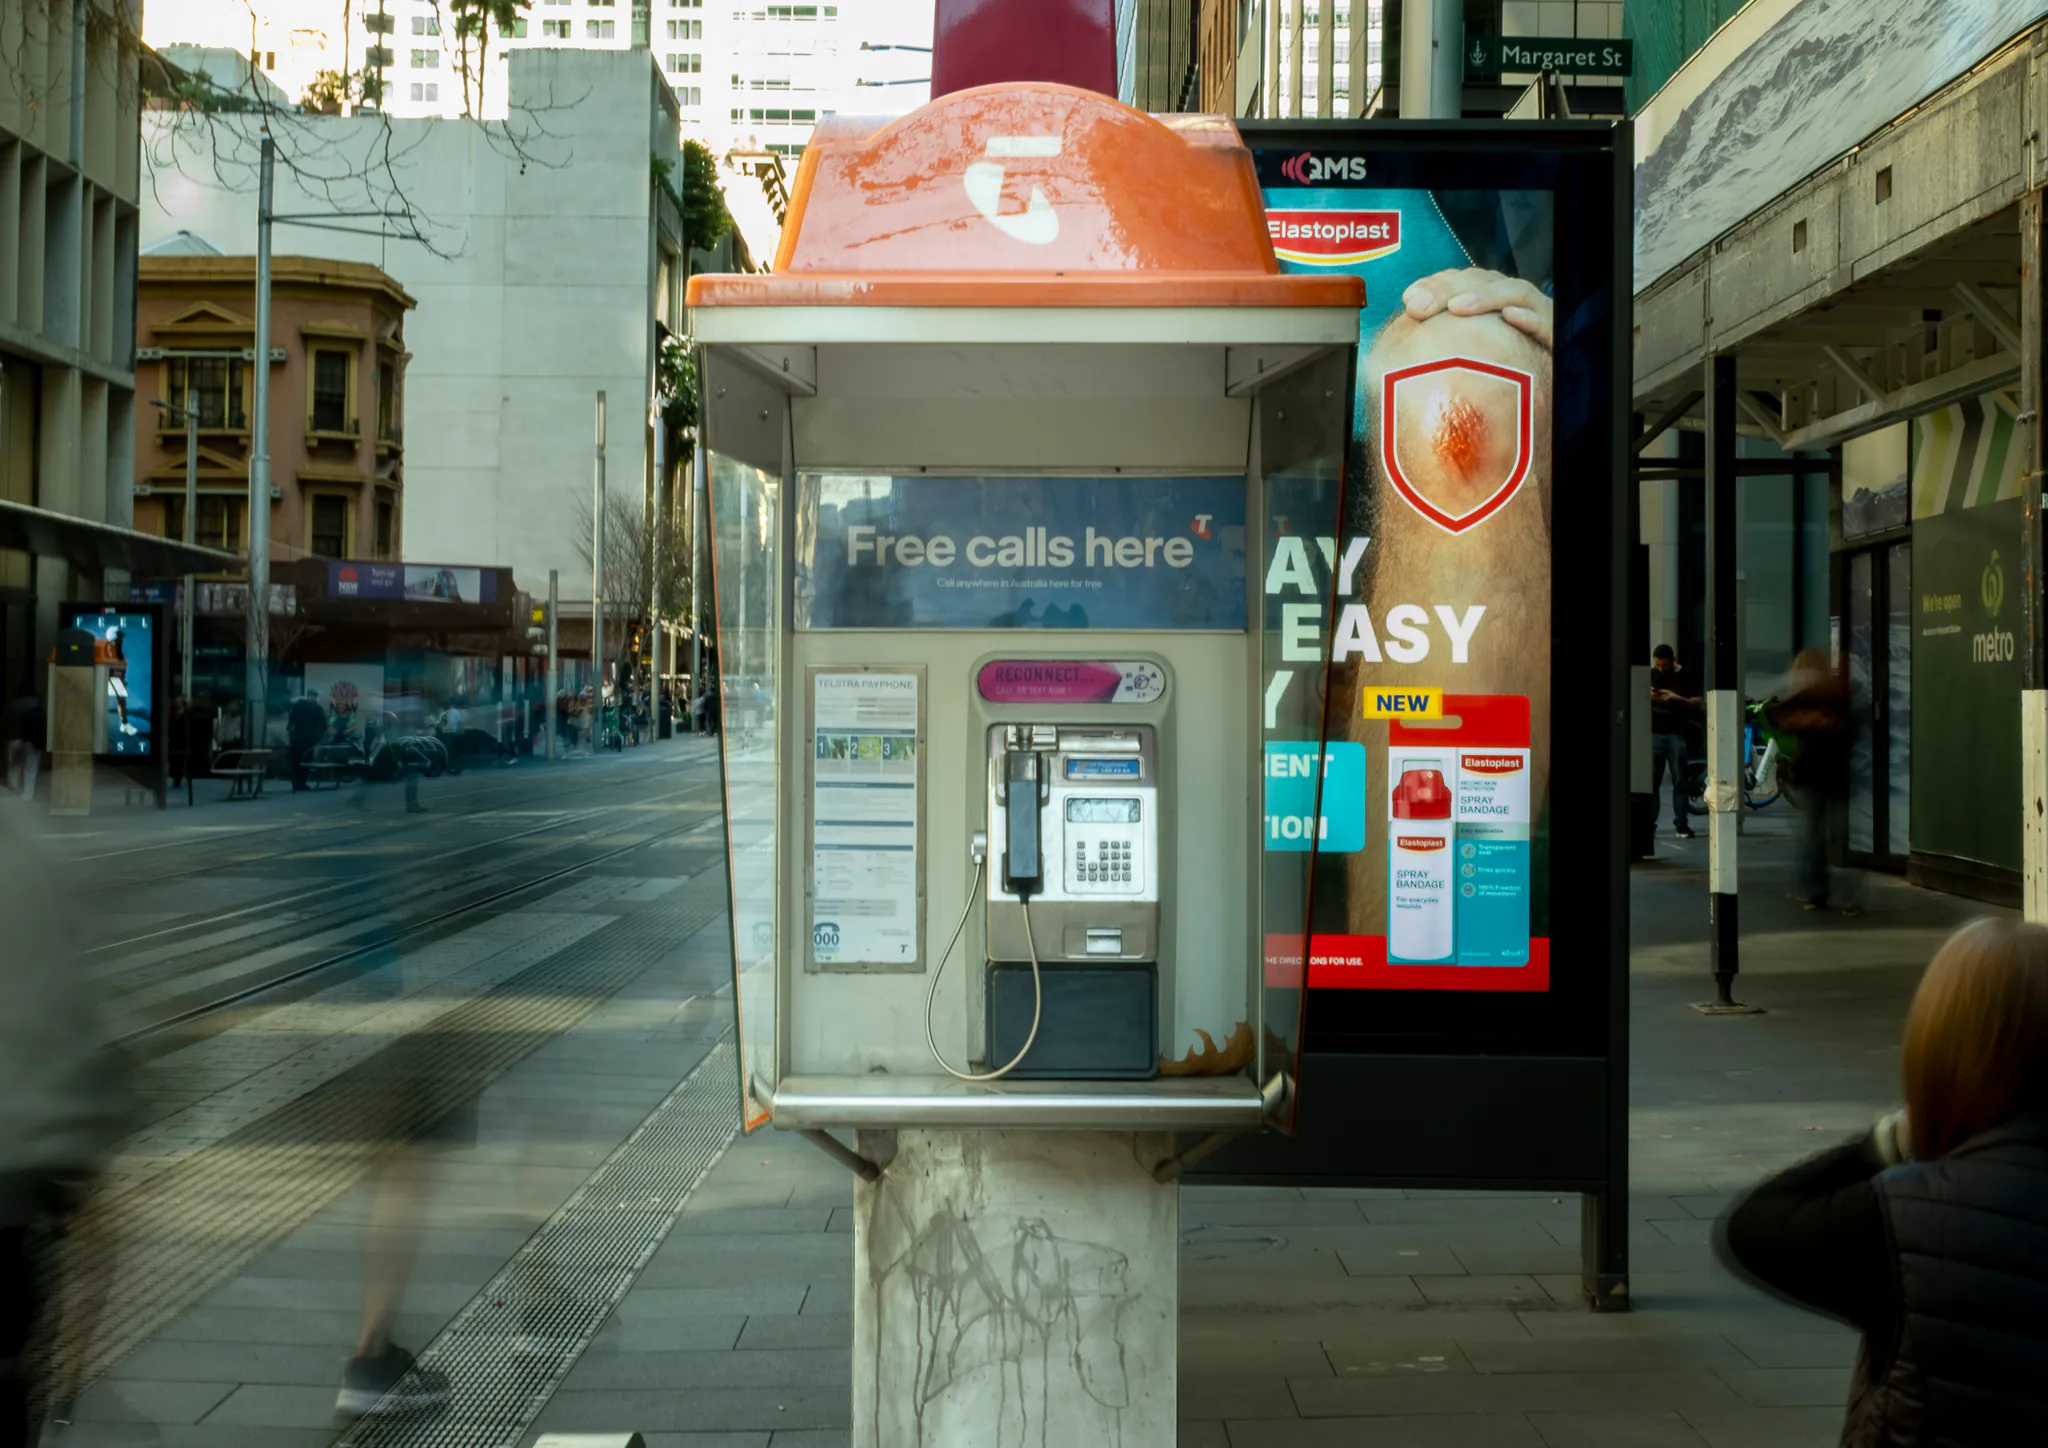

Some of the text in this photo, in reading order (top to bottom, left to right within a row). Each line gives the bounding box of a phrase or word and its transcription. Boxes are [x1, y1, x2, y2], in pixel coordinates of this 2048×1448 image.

[1502, 45, 1622, 70] Margaret St
[1299, 155, 1367, 183] QMS
[1269, 220, 1390, 244] Elastoplast
[847, 525, 1194, 569] Free calls here
[338, 581, 359, 591] NSW
[936, 578, 955, 588] Call
[955, 579, 999, 589] anywhere
[1009, 579, 1048, 588] Australia
[1049, 580, 1069, 589] here
[1070, 580, 1083, 589] for
[1084, 580, 1103, 589] free
[1922, 593, 1962, 614] We're open
[1282, 604, 1487, 664] EASY
[1973, 626, 2014, 663] metro
[818, 679, 914, 690] TELSTRA PAYPHONE
[1376, 694, 1430, 713] NEW
[818, 741, 824, 754] 1
[851, 742, 858, 755] 2
[883, 742, 891, 756] 3
[1264, 754, 1335, 778] ENT
[1465, 757, 1520, 769] Elastoplast
[1461, 795, 1494, 805] SPRAY
[1460, 805, 1510, 815] BANDAGE
[1264, 815, 1328, 840] ION
[1399, 839, 1443, 849] Elastoplast
[1396, 870, 1430, 879] SPRAY
[1396, 880, 1445, 889] BANDAGE
[1408, 896, 1439, 904] everyday
[814, 932, 840, 946] 000
[1328, 957, 1345, 966] FOR
[1345, 957, 1364, 967] USE.
